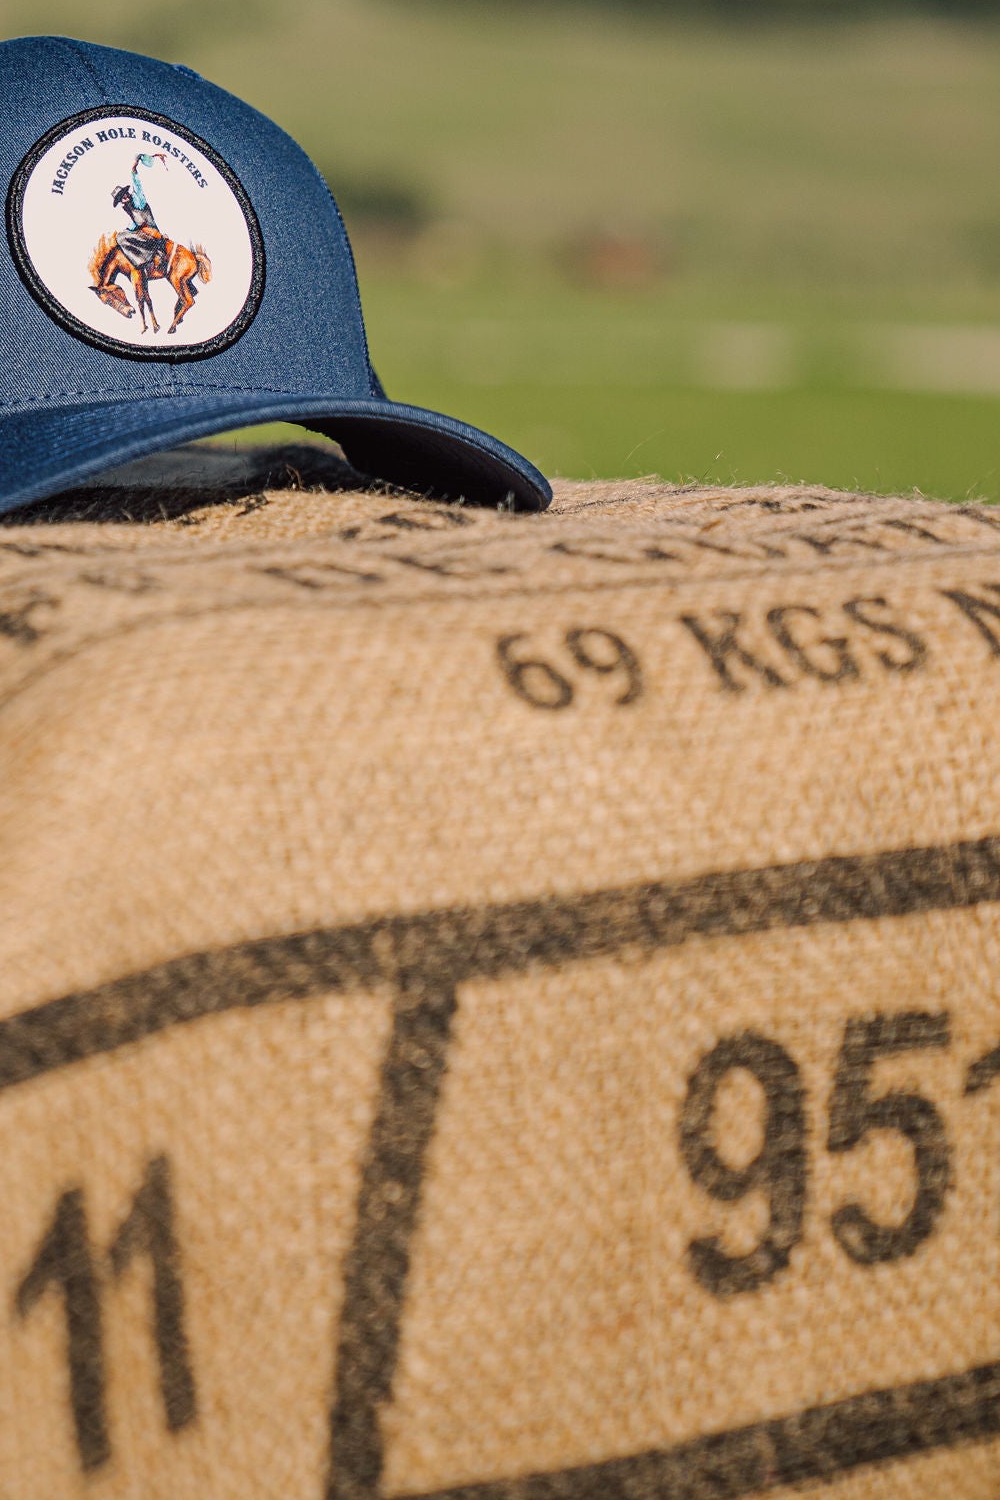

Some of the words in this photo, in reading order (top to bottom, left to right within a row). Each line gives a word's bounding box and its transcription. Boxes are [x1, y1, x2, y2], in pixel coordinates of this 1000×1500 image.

[51, 137, 95, 196] JACKSON
[96, 127, 137, 143] HOLE
[141, 130, 208, 188] ROASTERS
[495, 627, 643, 710] 69
[678, 594, 928, 693] KGS
[14, 1152, 198, 1474] 11
